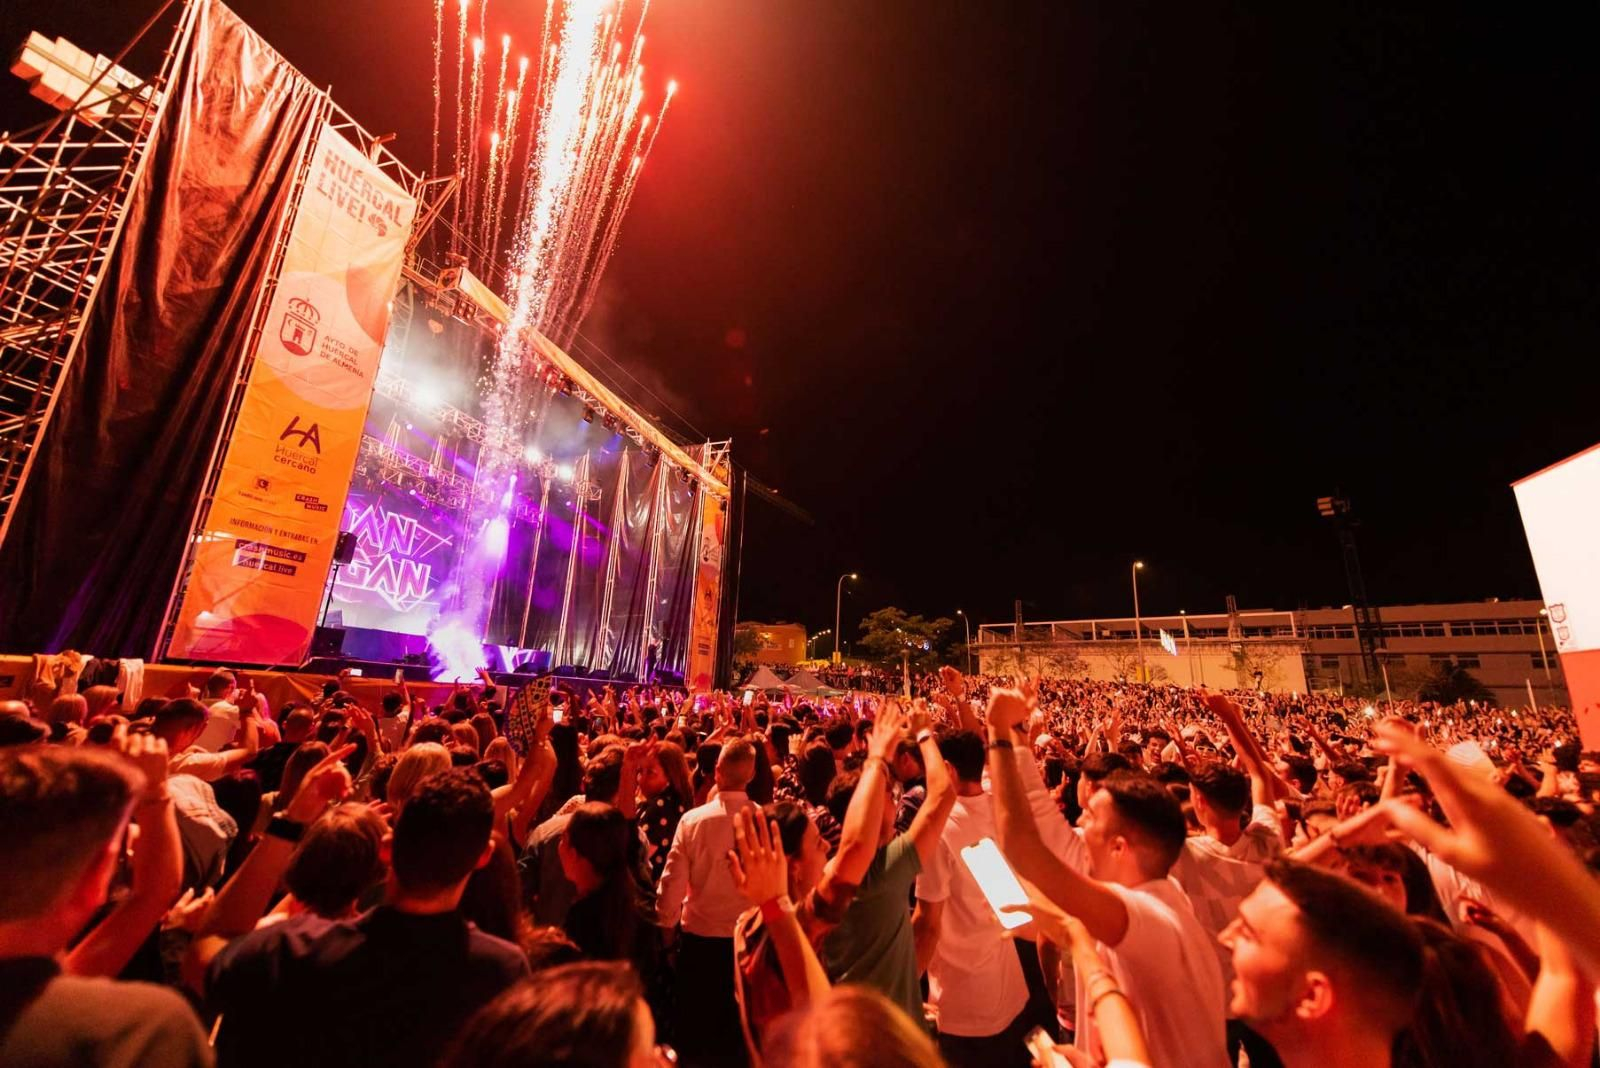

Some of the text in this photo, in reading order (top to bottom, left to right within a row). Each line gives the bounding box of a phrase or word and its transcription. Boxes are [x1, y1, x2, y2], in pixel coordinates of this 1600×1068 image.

[316, 172, 366, 223] LIVE!
[319, 350, 331, 361] DE
[348, 347, 360, 357] DE
[273, 454, 317, 475] cercano
[279, 530, 309, 544] ENTRADAS
